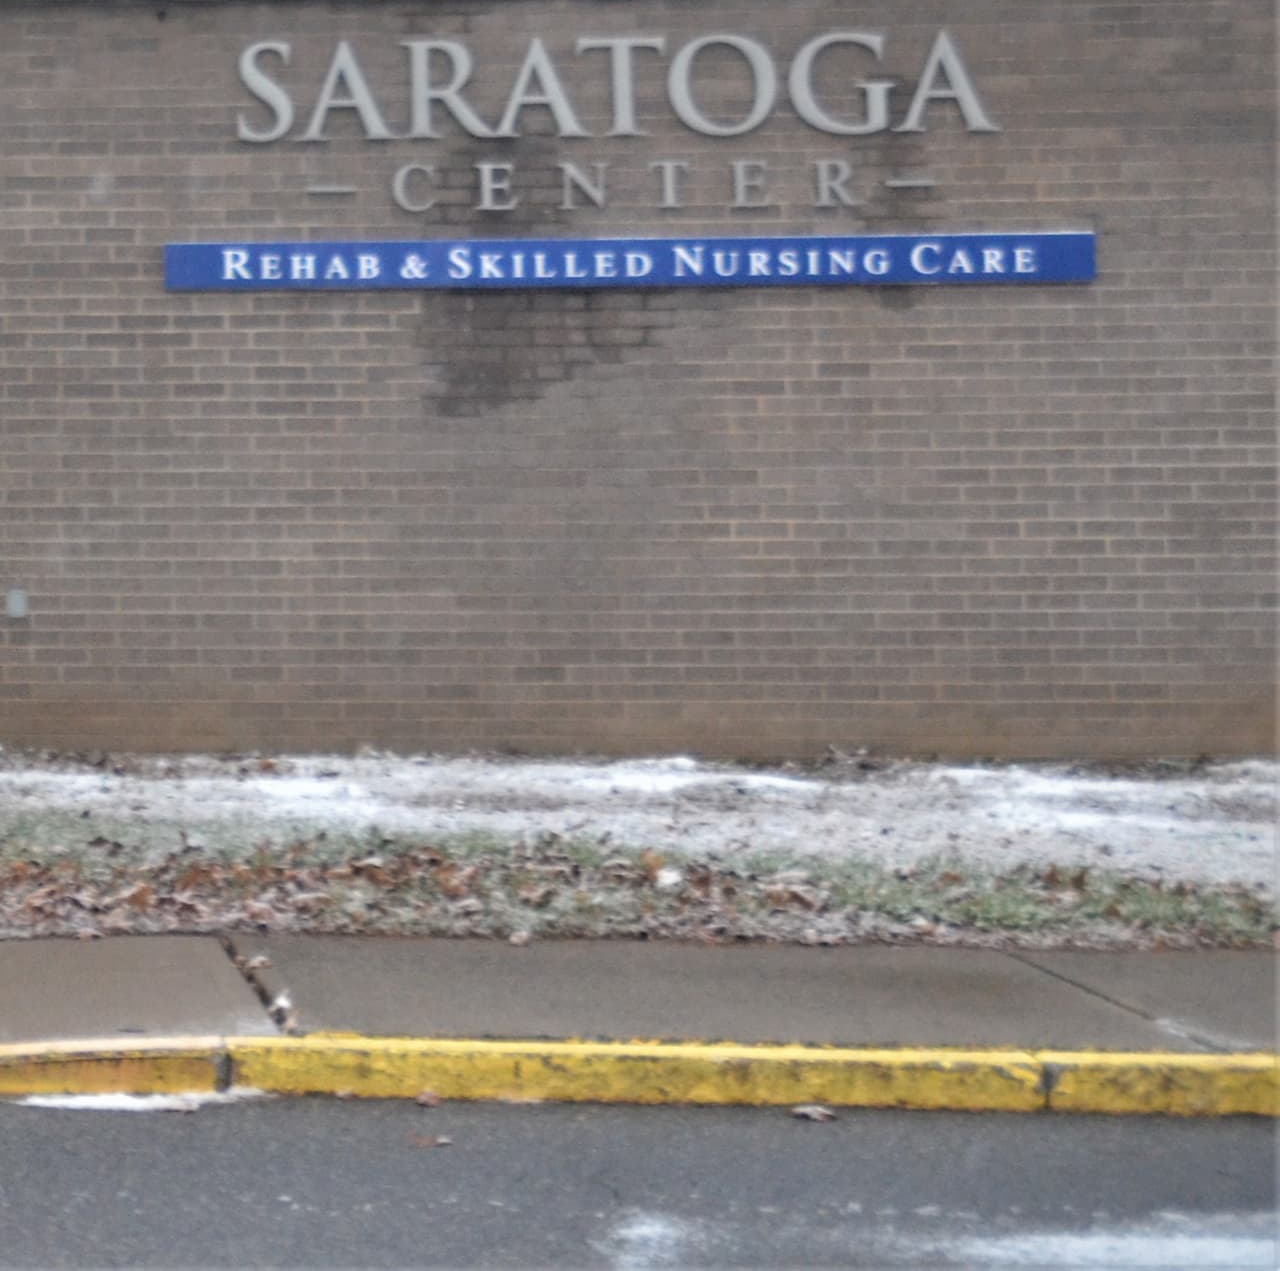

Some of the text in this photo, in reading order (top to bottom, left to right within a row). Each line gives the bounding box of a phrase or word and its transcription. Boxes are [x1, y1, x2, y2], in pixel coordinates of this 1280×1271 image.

[237, 30, 1000, 143] SARATOGA
[392, 158, 867, 212] CENTER
[400, 254, 428, 278] &
